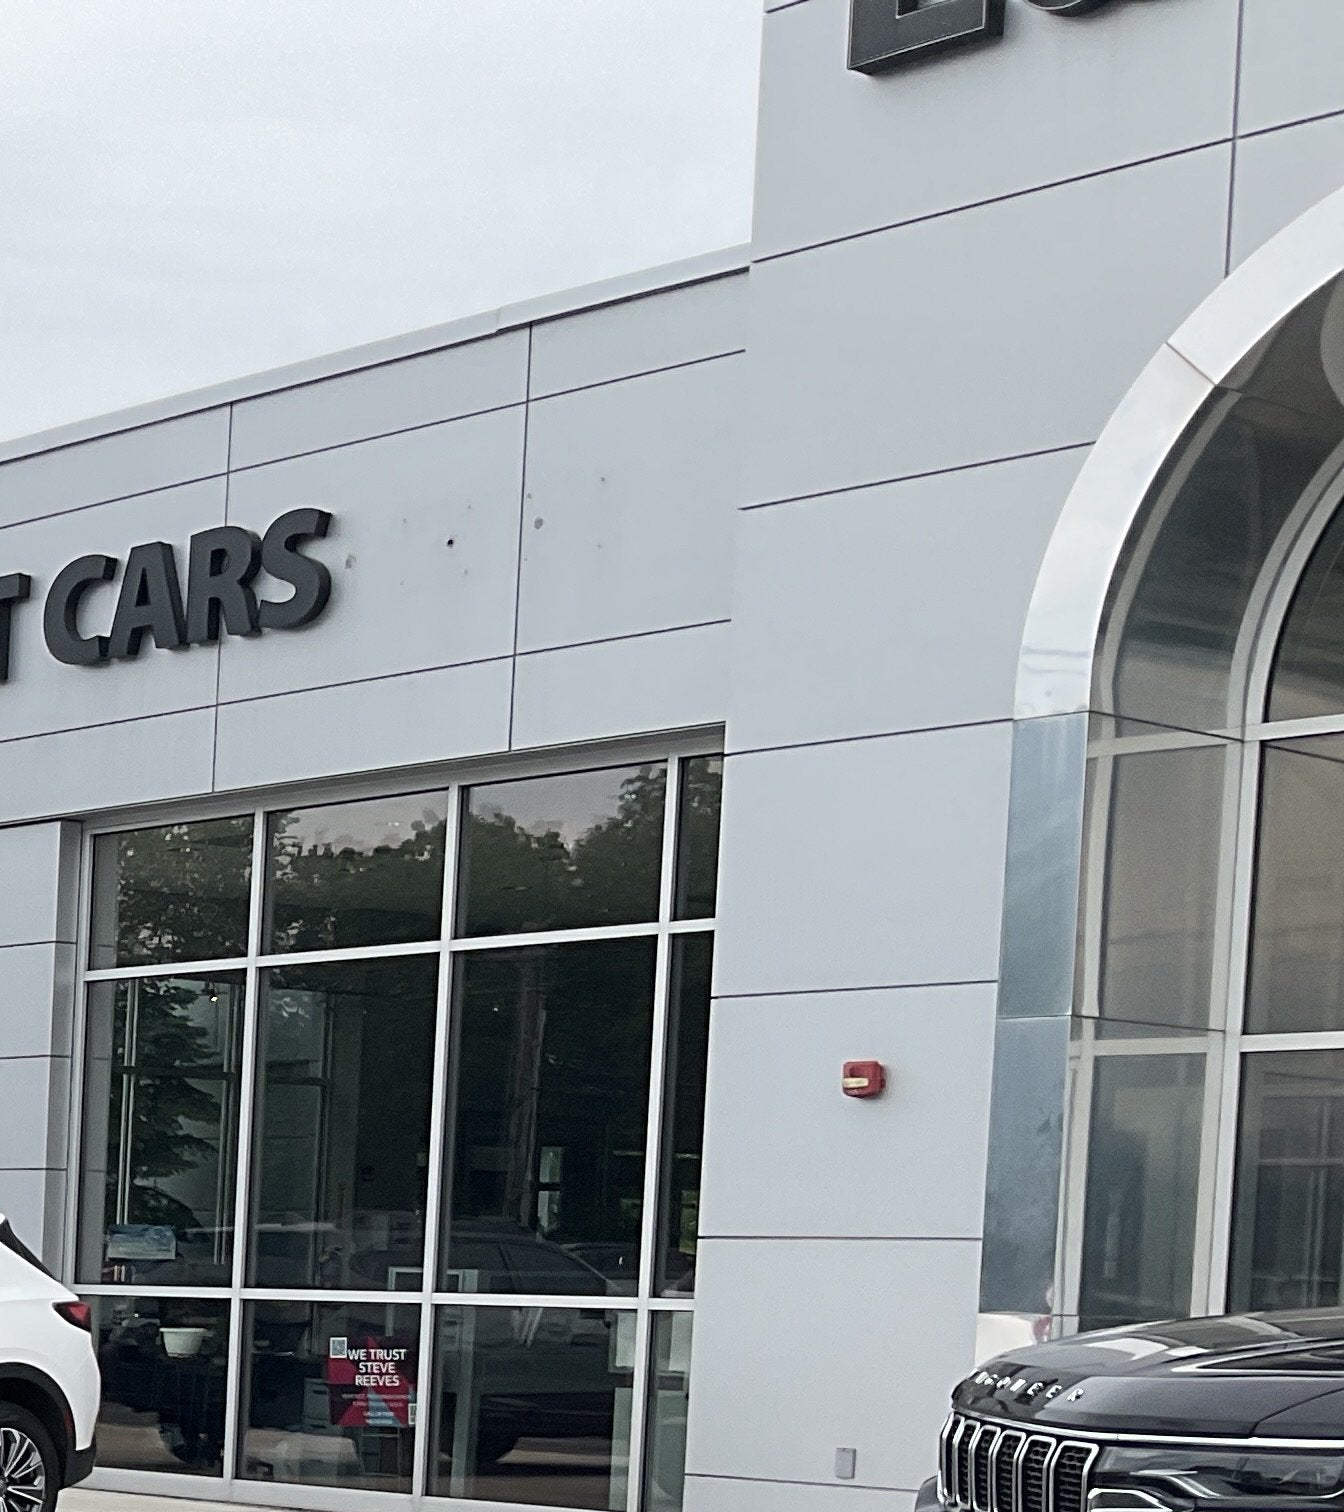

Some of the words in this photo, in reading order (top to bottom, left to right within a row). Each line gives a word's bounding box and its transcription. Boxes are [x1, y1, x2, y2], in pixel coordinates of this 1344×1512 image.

[43, 508, 332, 666] CARS
[347, 1349, 367, 1361] WE
[370, 1349, 407, 1361] TRUST
[358, 1362, 396, 1374] STEVE
[355, 1375, 400, 1387] REEVES
